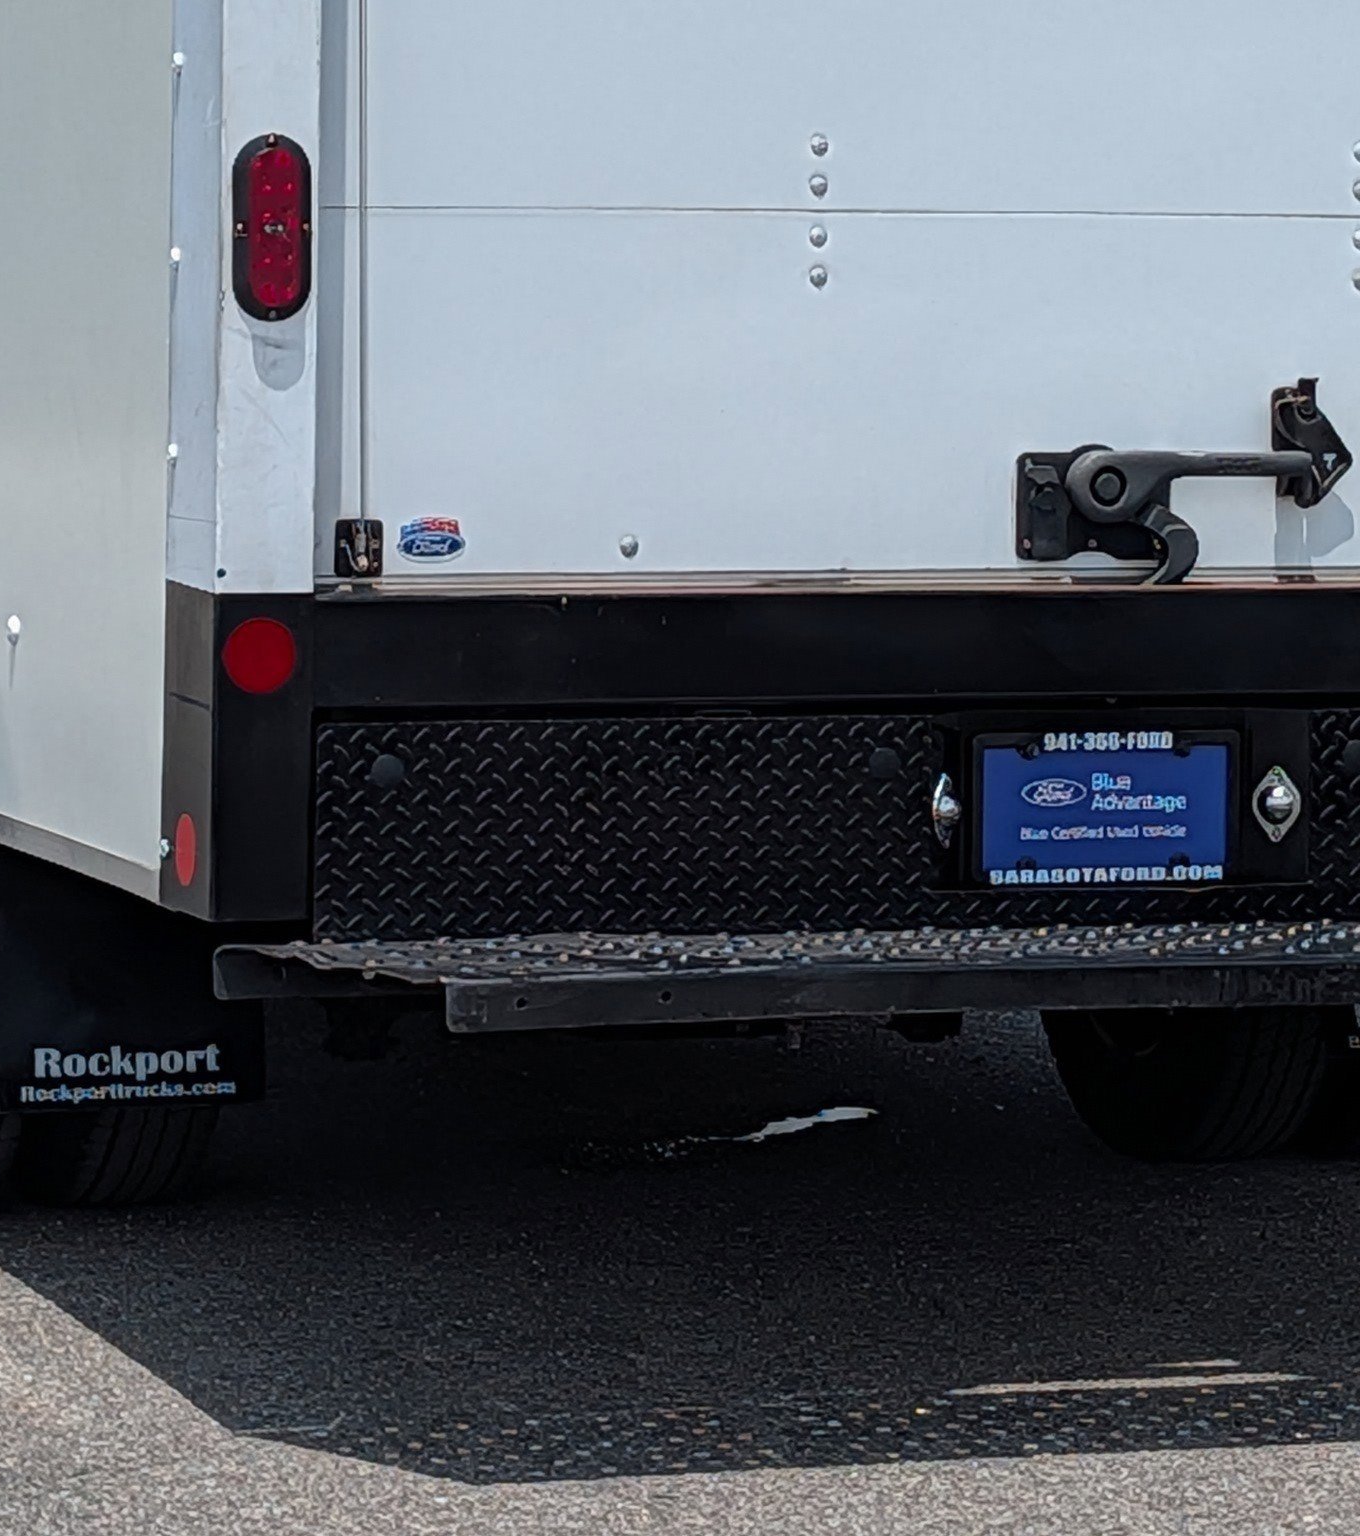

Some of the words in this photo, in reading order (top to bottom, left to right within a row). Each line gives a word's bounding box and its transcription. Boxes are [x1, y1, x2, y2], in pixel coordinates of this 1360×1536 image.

[1091, 772, 1132, 791] Blue
[1090, 793, 1188, 813] Advantage
[989, 864, 1224, 886] SARASOTAFORD.COM
[34, 1044, 220, 1081] Rockport
[20, 1081, 237, 1104] Rockporttrucks.com
